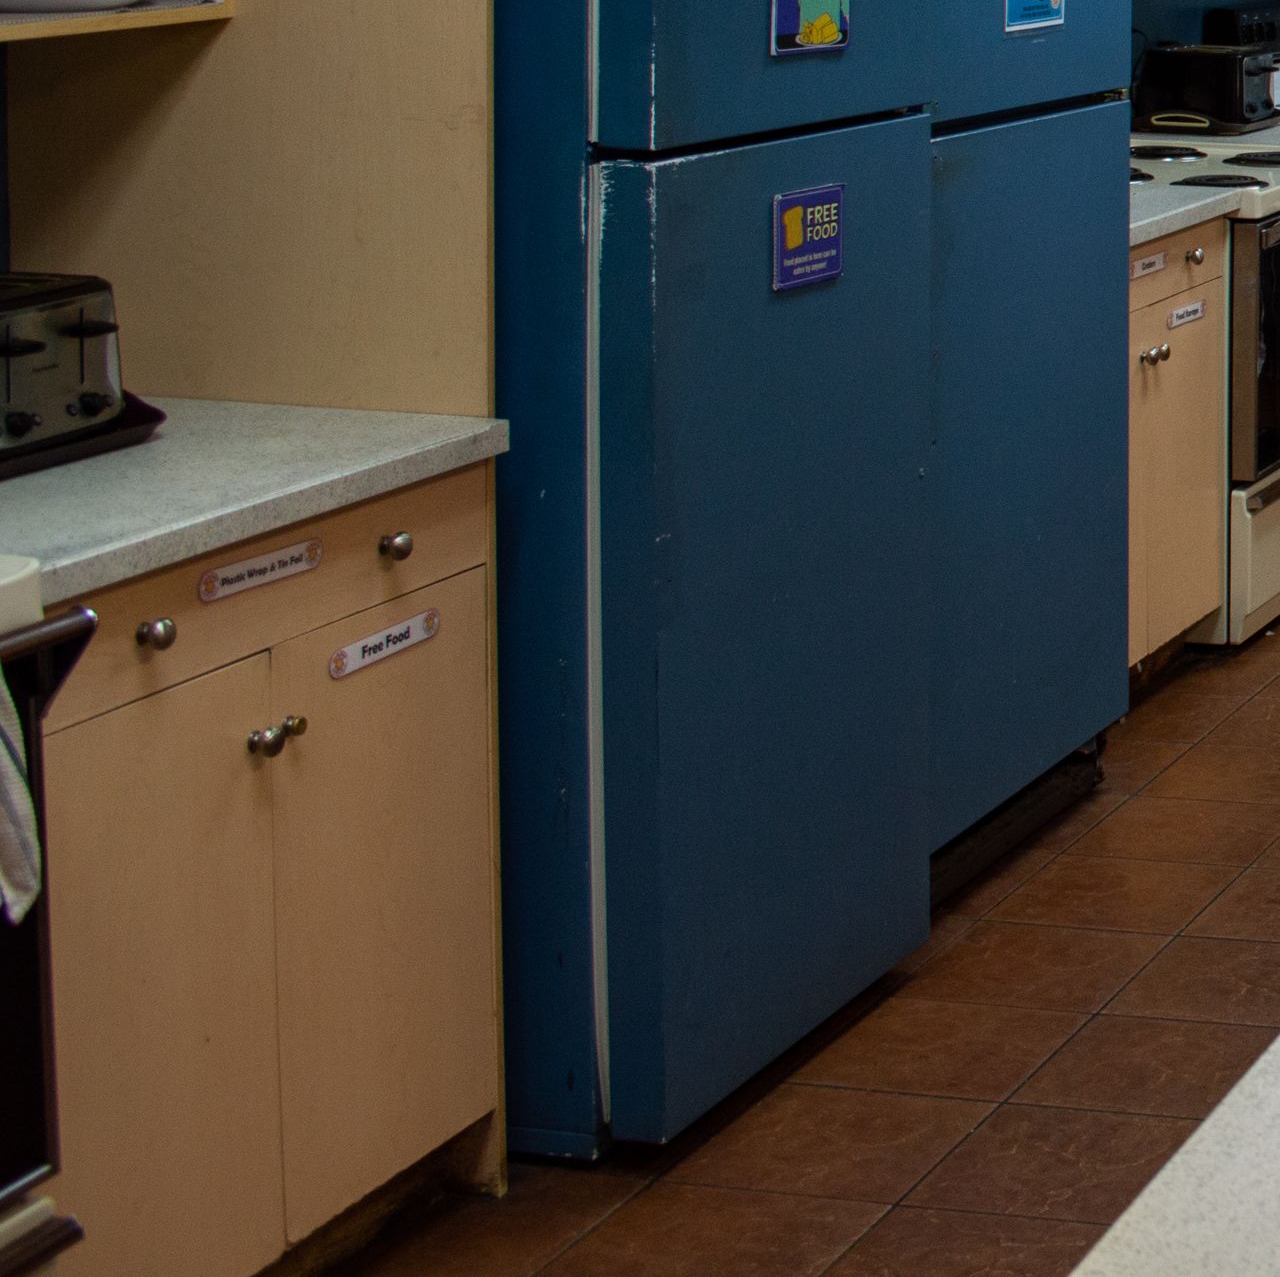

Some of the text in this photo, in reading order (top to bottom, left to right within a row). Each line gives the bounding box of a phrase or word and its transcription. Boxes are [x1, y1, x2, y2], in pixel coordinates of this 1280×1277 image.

[807, 203, 838, 225] FREE
[807, 222, 838, 242] FOOD
[221, 553, 304, 587] Plastic Wrap & Tin Foil
[361, 626, 411, 660] Free Food
